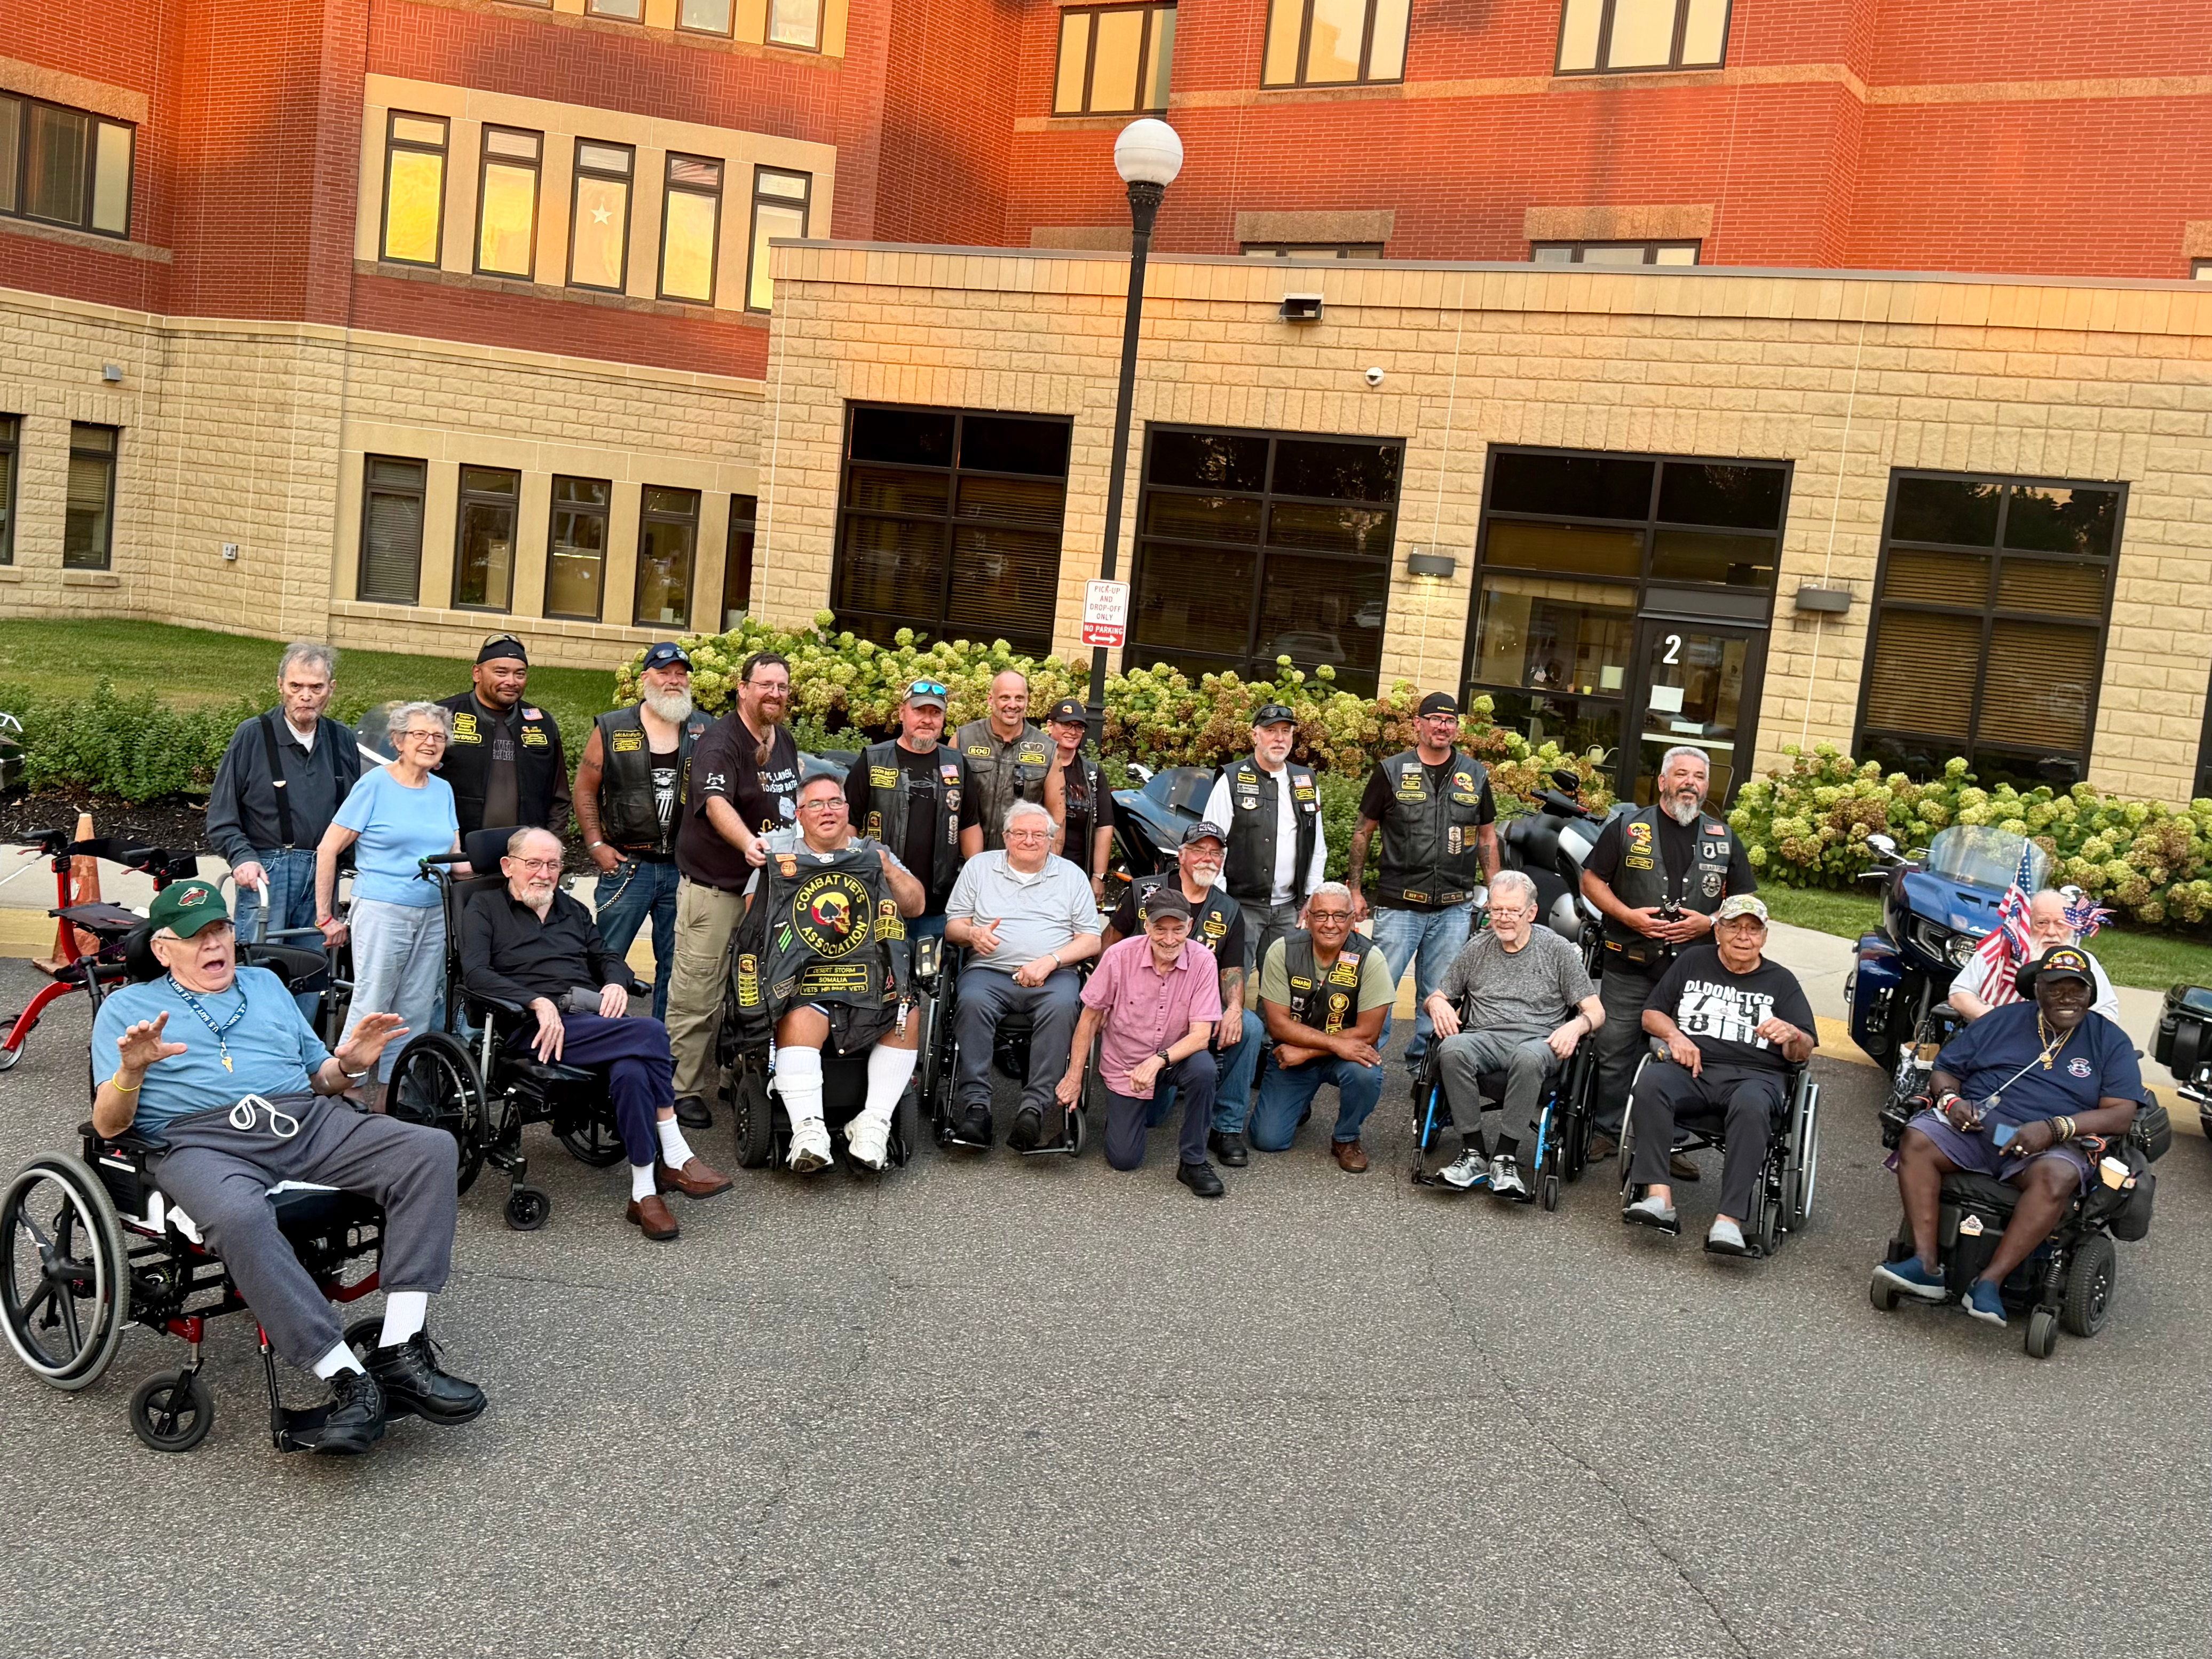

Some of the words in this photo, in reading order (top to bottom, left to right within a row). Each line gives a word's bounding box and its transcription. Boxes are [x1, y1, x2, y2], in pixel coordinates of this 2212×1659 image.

[1094, 586, 1120, 594] PICK-UP
[1089, 604, 1122, 613] DROP-OFF
[1095, 626, 1124, 635] PARKING
[1663, 635, 1681, 665] 2
[761, 783, 784, 793] TOASTER
[784, 779, 798, 791] BATH
[796, 875, 841, 911] COMBAT
[844, 877, 865, 903] VETS
[802, 921, 867, 954] ASSOCIATION
[171, 981, 185, 993] NAVY
[196, 1009, 212, 1023] NAVY
